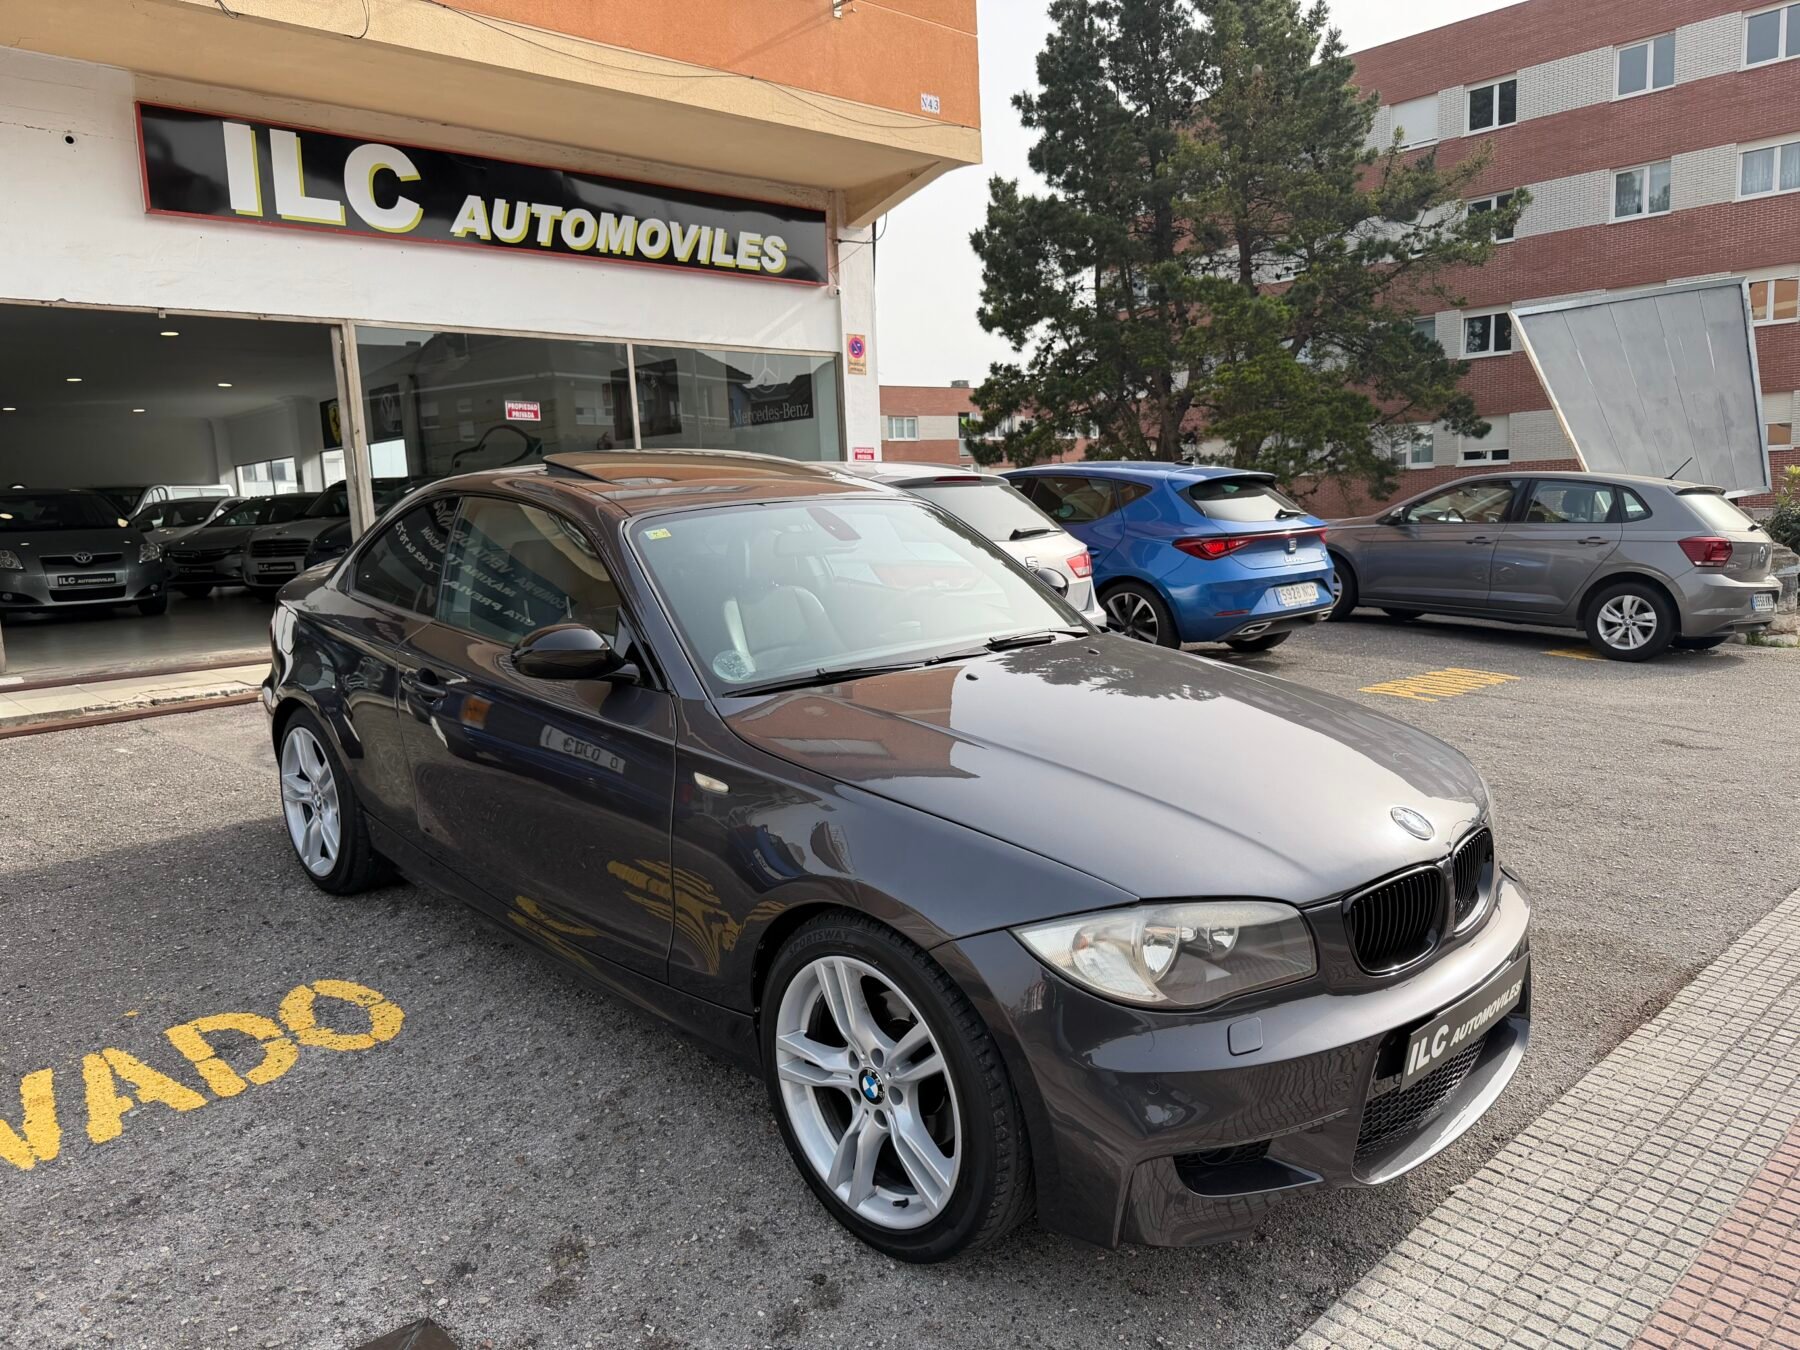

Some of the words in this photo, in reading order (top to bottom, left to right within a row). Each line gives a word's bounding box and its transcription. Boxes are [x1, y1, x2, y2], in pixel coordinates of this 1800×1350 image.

[222, 121, 424, 234] ILC
[450, 194, 787, 274] AUTOMOVILES
[507, 402, 538, 411] PROPIEDAD
[511, 410, 535, 419] PRIVADA
[733, 402, 810, 425] Mercedes-Benz
[58, 576, 76, 585] ILC
[1407, 1024, 1449, 1076] ILC
[1449, 979, 1522, 1047] AUTOMOVILES
